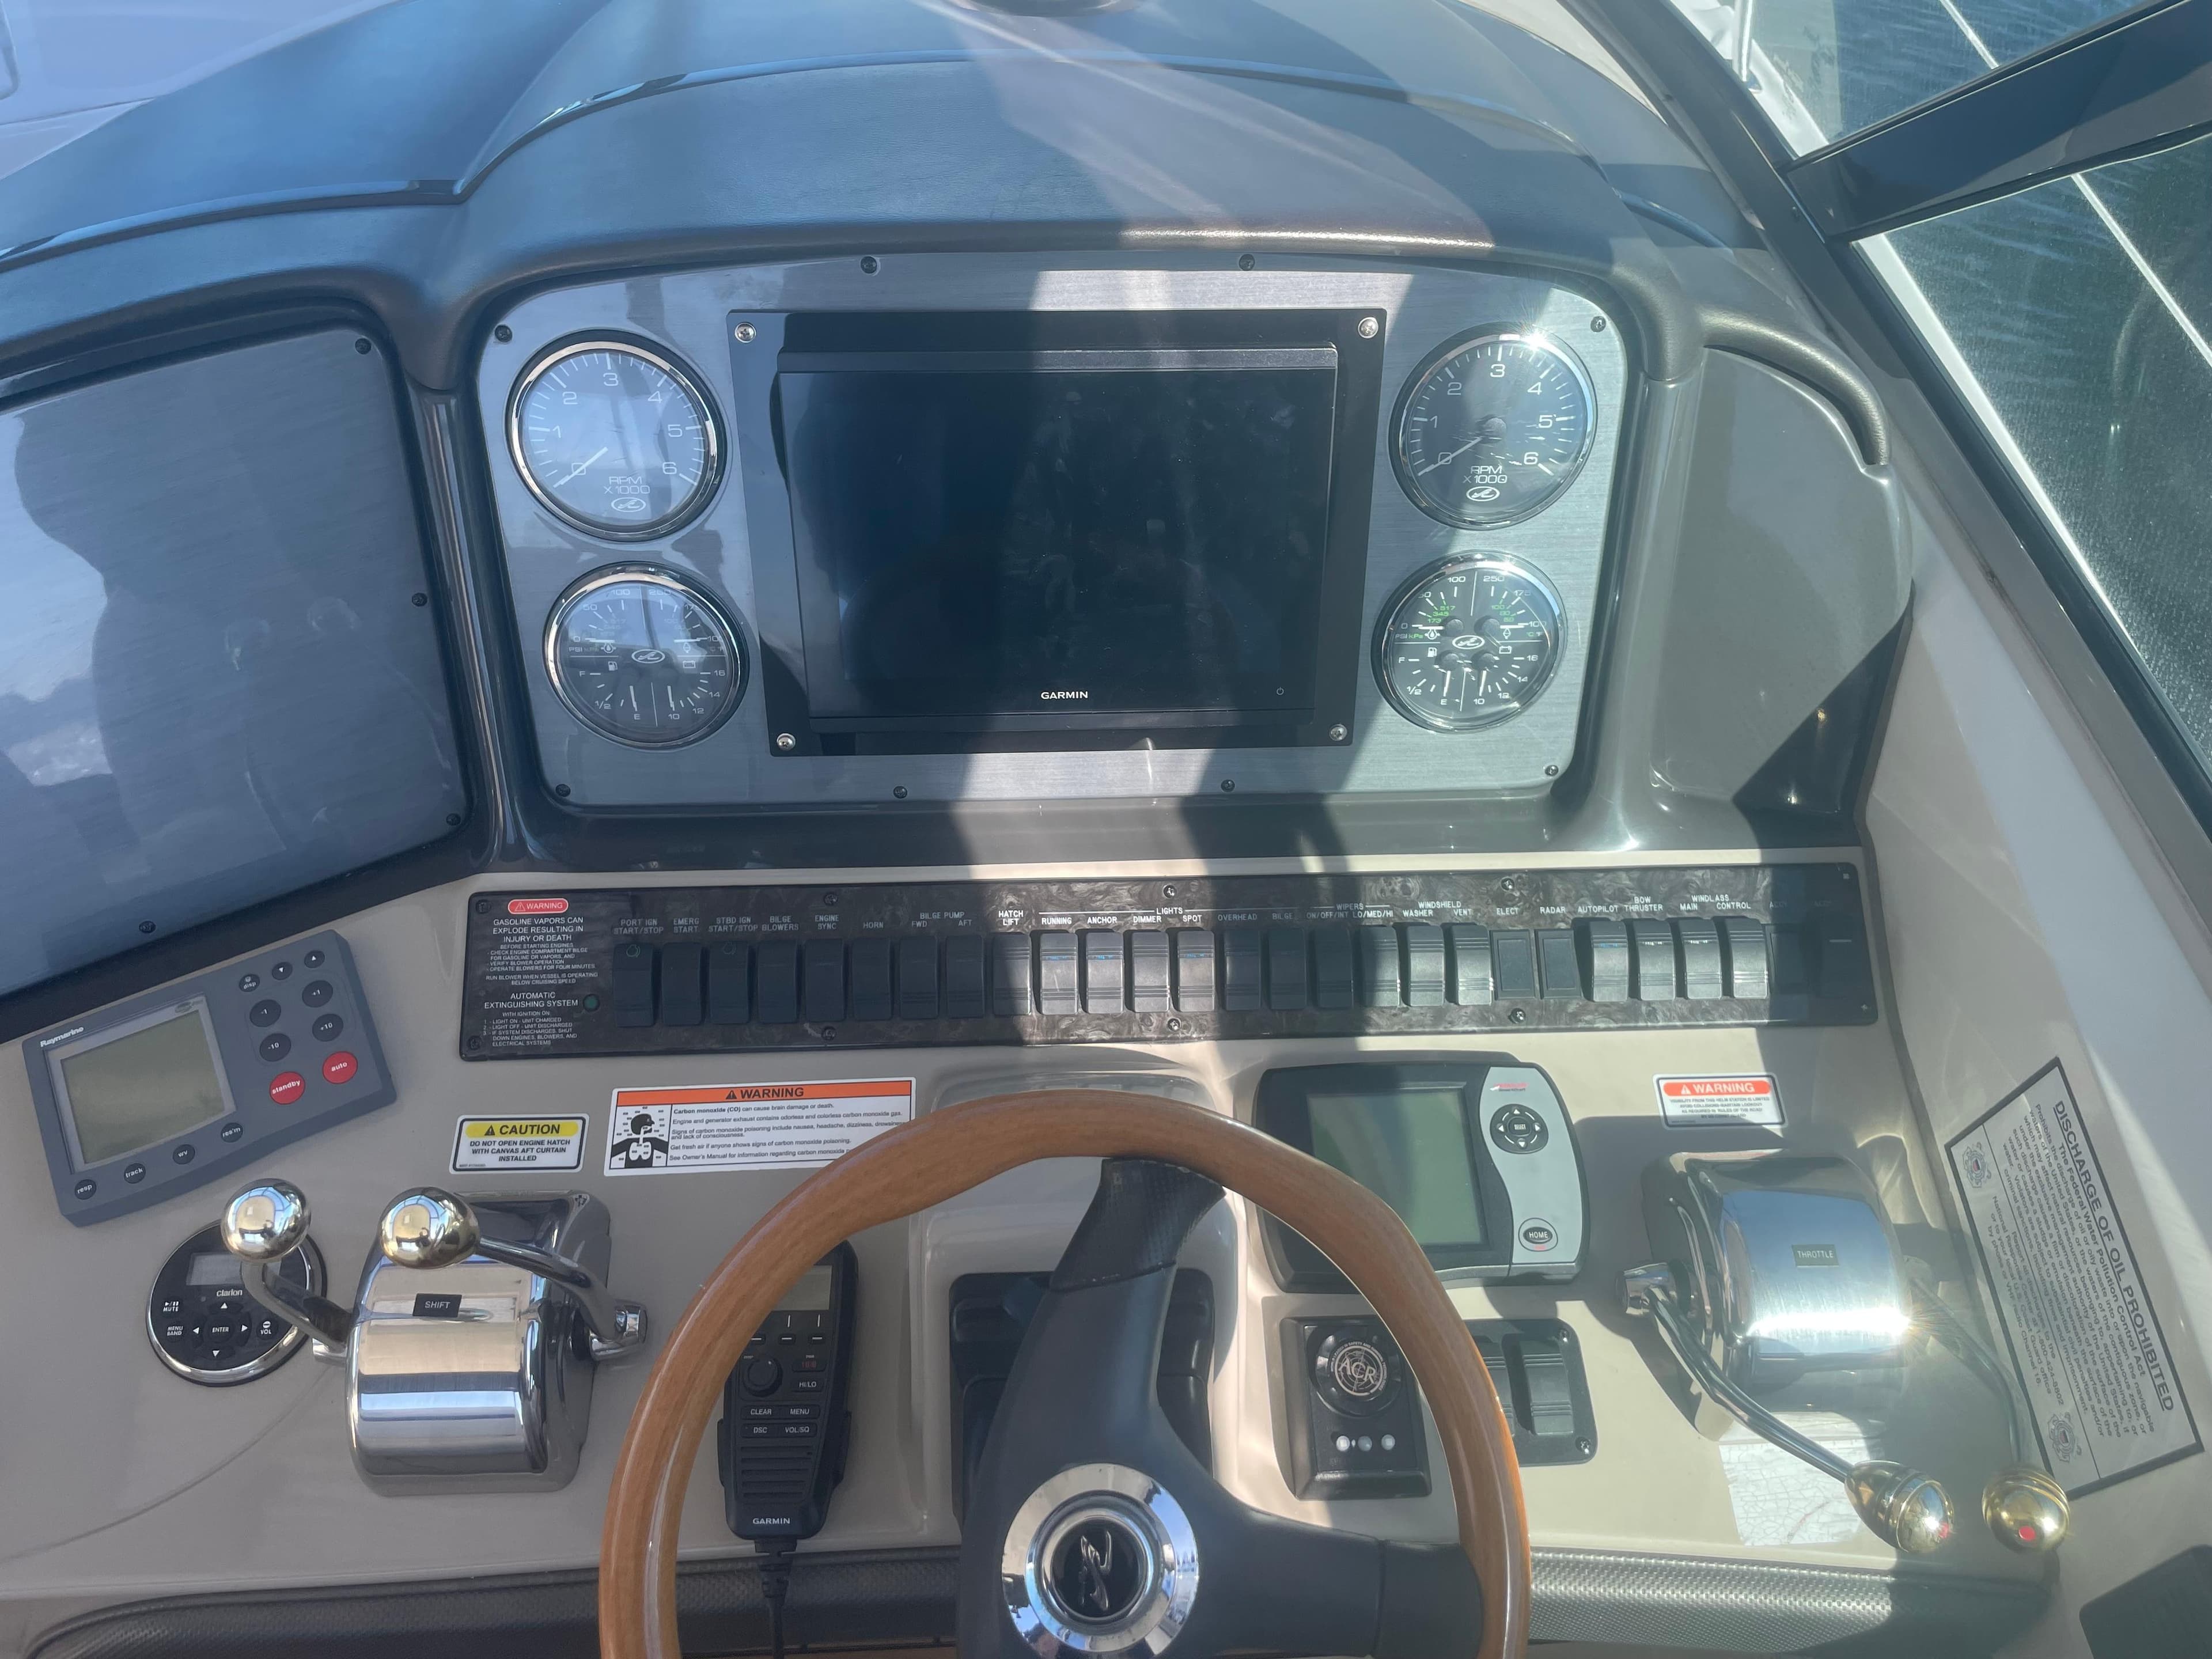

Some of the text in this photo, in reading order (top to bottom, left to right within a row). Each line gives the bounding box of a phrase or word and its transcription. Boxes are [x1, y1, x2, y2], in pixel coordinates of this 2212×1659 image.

[1490, 364, 1505, 377] 3
[603, 373, 619, 386] 3
[1447, 382, 1462, 395] 2
[1527, 382, 1542, 395] 4
[562, 391, 578, 405] 2
[647, 391, 662, 403] 4
[1430, 415, 1438, 428] 1
[1538, 415, 1553, 428] 5
[552, 425, 561, 438] 1
[668, 424, 683, 437] 5
[1437, 452, 1452, 465] 0
[1524, 452, 1538, 464] 6
[571, 463, 586, 475] 0
[662, 462, 677, 474] 6
[1470, 465, 1502, 474] RPM
[608, 476, 642, 484] RPM
[1040, 691, 1088, 699] GARMIN
[1406, 686, 1422, 695] 1/2
[594, 700, 612, 710] 1/2
[1691, 895, 1729, 903] WINDLASS
[1156, 907, 1183, 915] LIGHTS
[1540, 906, 1566, 914] RADAR
[1577, 905, 1619, 913] AUTOPILOT
[1624, 904, 1664, 912] THRUSTER
[1680, 903, 1698, 911] MAIN
[998, 910, 1024, 918] HATCH
[1217, 913, 1257, 921] OVERHEAD
[1306, 911, 1349, 919] ON/OFF/INT
[1353, 910, 1393, 918] LO/MED/HI
[1402, 909, 1434, 917] WASHER
[673, 917, 700, 925] EMERG
[1041, 917, 1073, 925] RUNNING
[1086, 916, 1118, 924] ANCHOR
[1132, 915, 1162, 923] DIMMER
[1183, 914, 1203, 922] SPOT
[620, 919, 643, 927] PORT
[762, 923, 799, 931] BLOWERS
[613, 926, 664, 935] START/STOP
[709, 924, 759, 932] START/STOP
[510, 991, 556, 999] AUTOMATIC
[484, 1001, 545, 1009] EXTINGUISHING
[320, 1022, 333, 1031] +10
[39, 1026, 84, 1047] Raymarine
[267, 1042, 279, 1050] -10
[331, 1061, 348, 1072] auto
[272, 1080, 301, 1094] standby
[1692, 1082, 1755, 1093] WARNING
[741, 1087, 804, 1099] WARNING
[499, 1124, 560, 1135] CAUTION
[125, 1168, 143, 1179] track
[77, 1184, 93, 1195] resp
[1797, 1250, 1834, 1258] THROTTLE
[2055, 1100, 2174, 1411] DISCHARGE OF OIL PROHIBITED
[2059, 1144, 2146, 1376] The Federal Water Pollution Control Act
[425, 1301, 451, 1309] SHIFT
[1338, 1357, 1376, 1385] ACR
